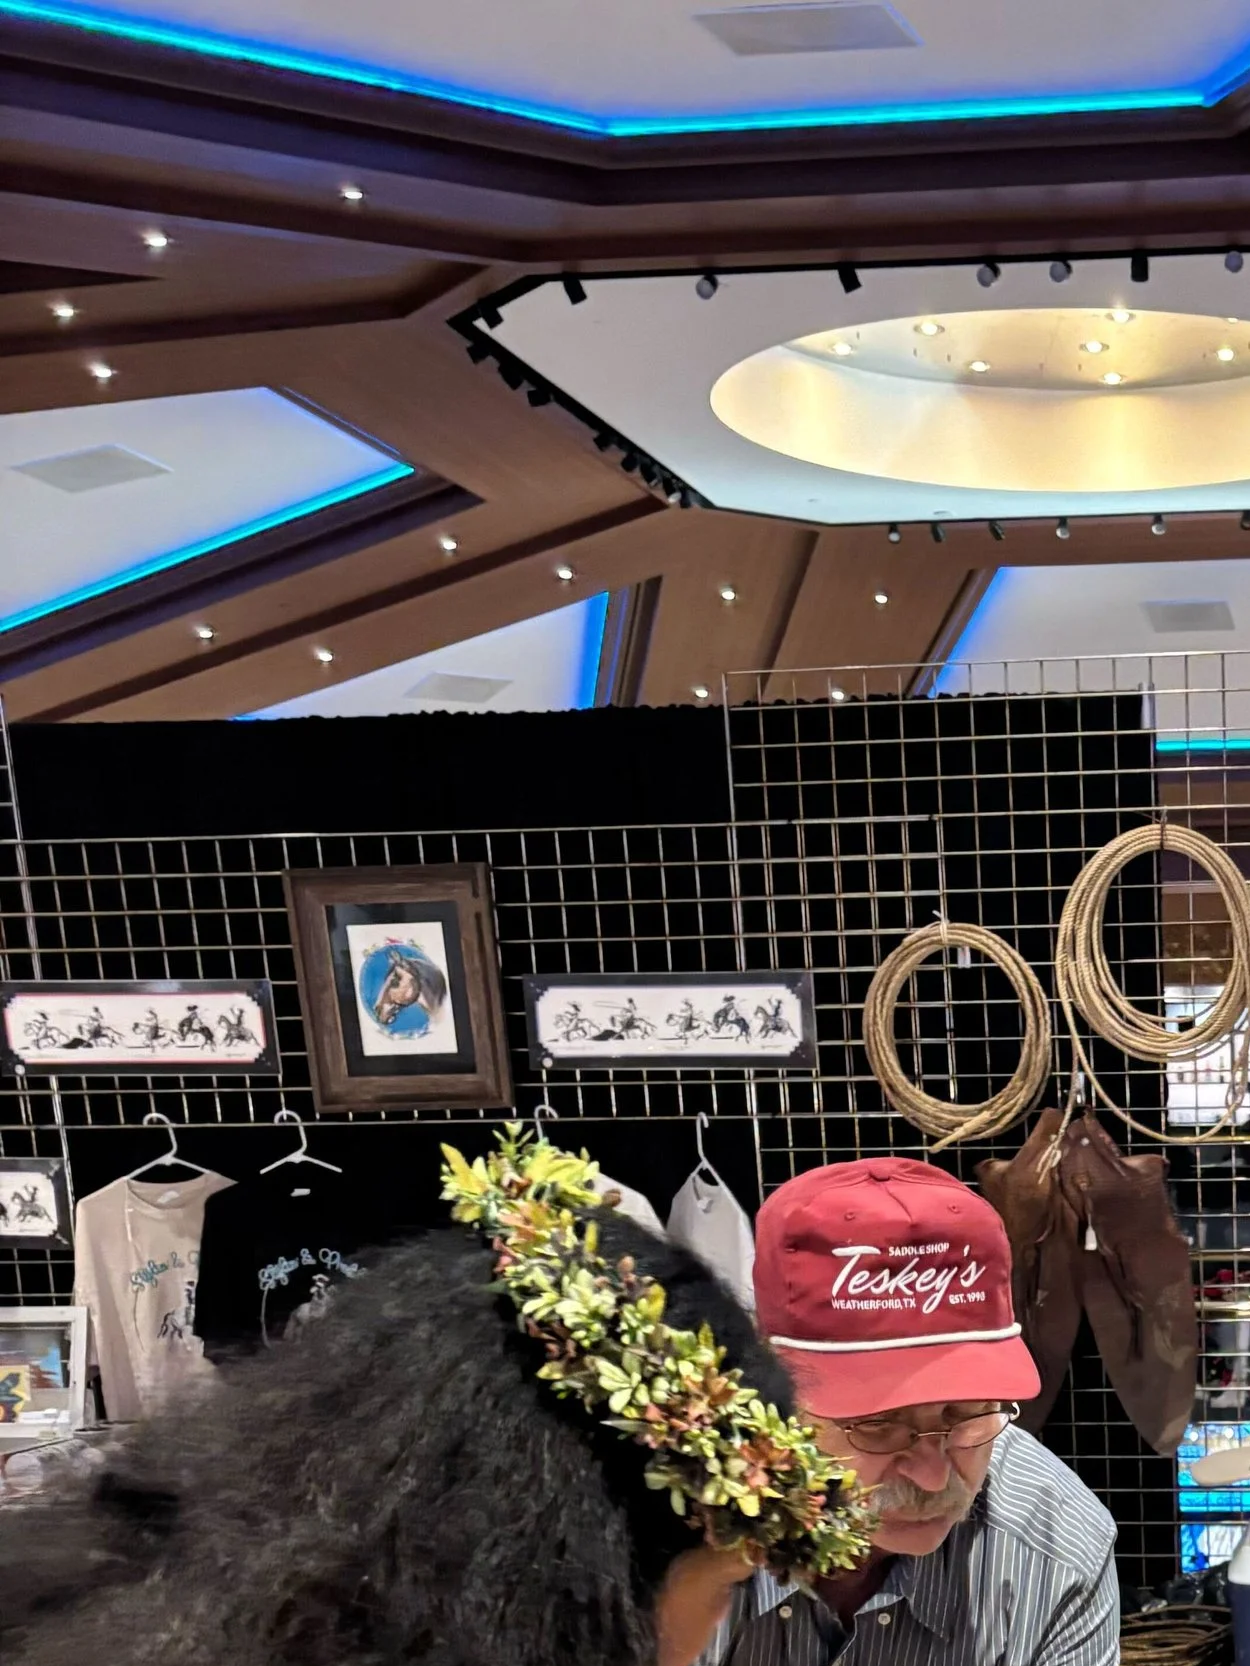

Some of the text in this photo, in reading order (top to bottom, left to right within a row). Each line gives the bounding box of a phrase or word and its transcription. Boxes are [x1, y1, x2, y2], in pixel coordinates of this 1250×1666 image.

[926, 1242, 950, 1254] SHOP
[831, 1244, 987, 1314] Teskey's
[902, 1297, 916, 1309] TX
[948, 1293, 967, 1305] EST.
